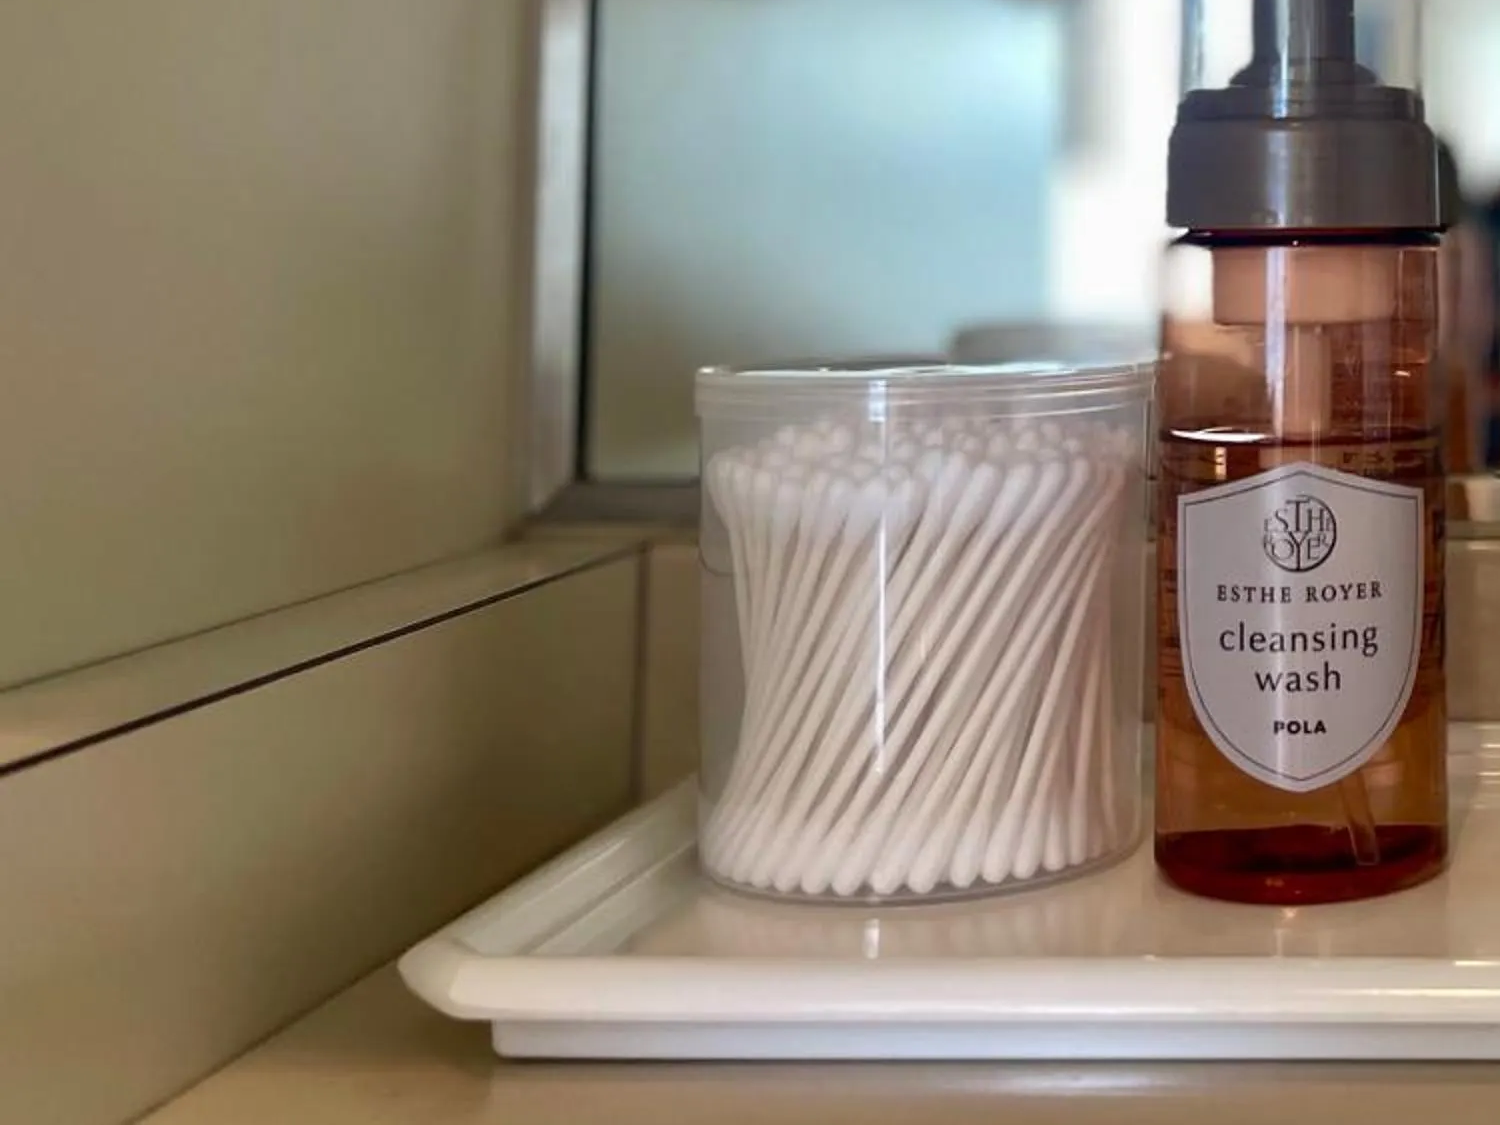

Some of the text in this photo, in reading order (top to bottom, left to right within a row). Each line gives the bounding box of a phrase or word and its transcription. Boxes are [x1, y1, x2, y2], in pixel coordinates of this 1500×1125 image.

[1216, 580, 1383, 604] ESTHE ROYER
[1218, 620, 1379, 658] cleansing
[1253, 661, 1342, 693] wash
[1273, 719, 1328, 736] POLA
